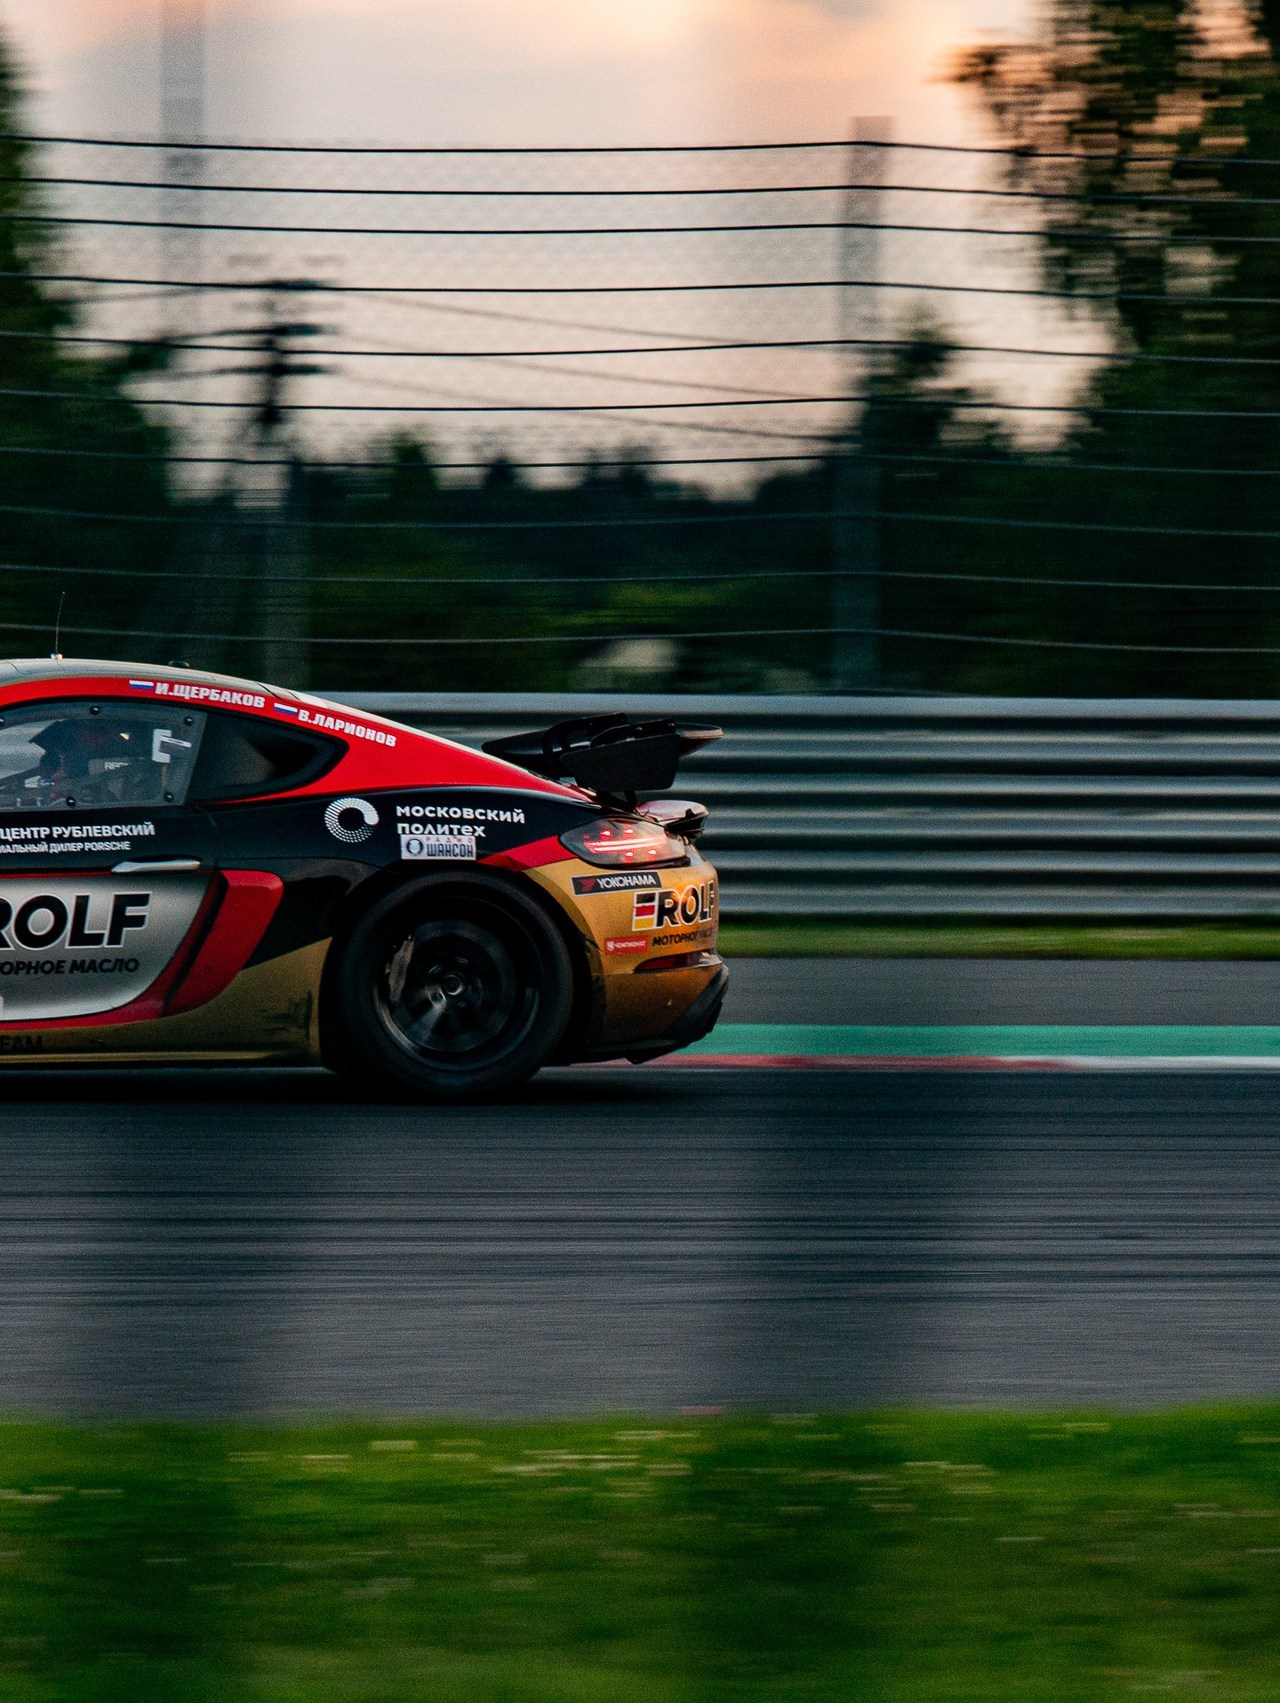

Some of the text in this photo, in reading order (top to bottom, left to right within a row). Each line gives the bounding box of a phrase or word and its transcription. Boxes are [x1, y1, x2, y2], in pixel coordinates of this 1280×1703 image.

[155, 682, 265, 709] И.ЩЕРБАКОВ
[297, 708, 397, 748] В.ЛАРИОНОВ
[0, 826, 50, 842] ЦЕНТР
[52, 821, 155, 838] РУБЛЕВСКИЙ
[49, 842, 84, 854] ДИЛЕР
[84, 841, 131, 851] PORSCHE
[426, 843, 474, 858] ШАНСОН
[597, 874, 656, 889] YOKOHAMA
[69, 958, 140, 975] МАСЛО
